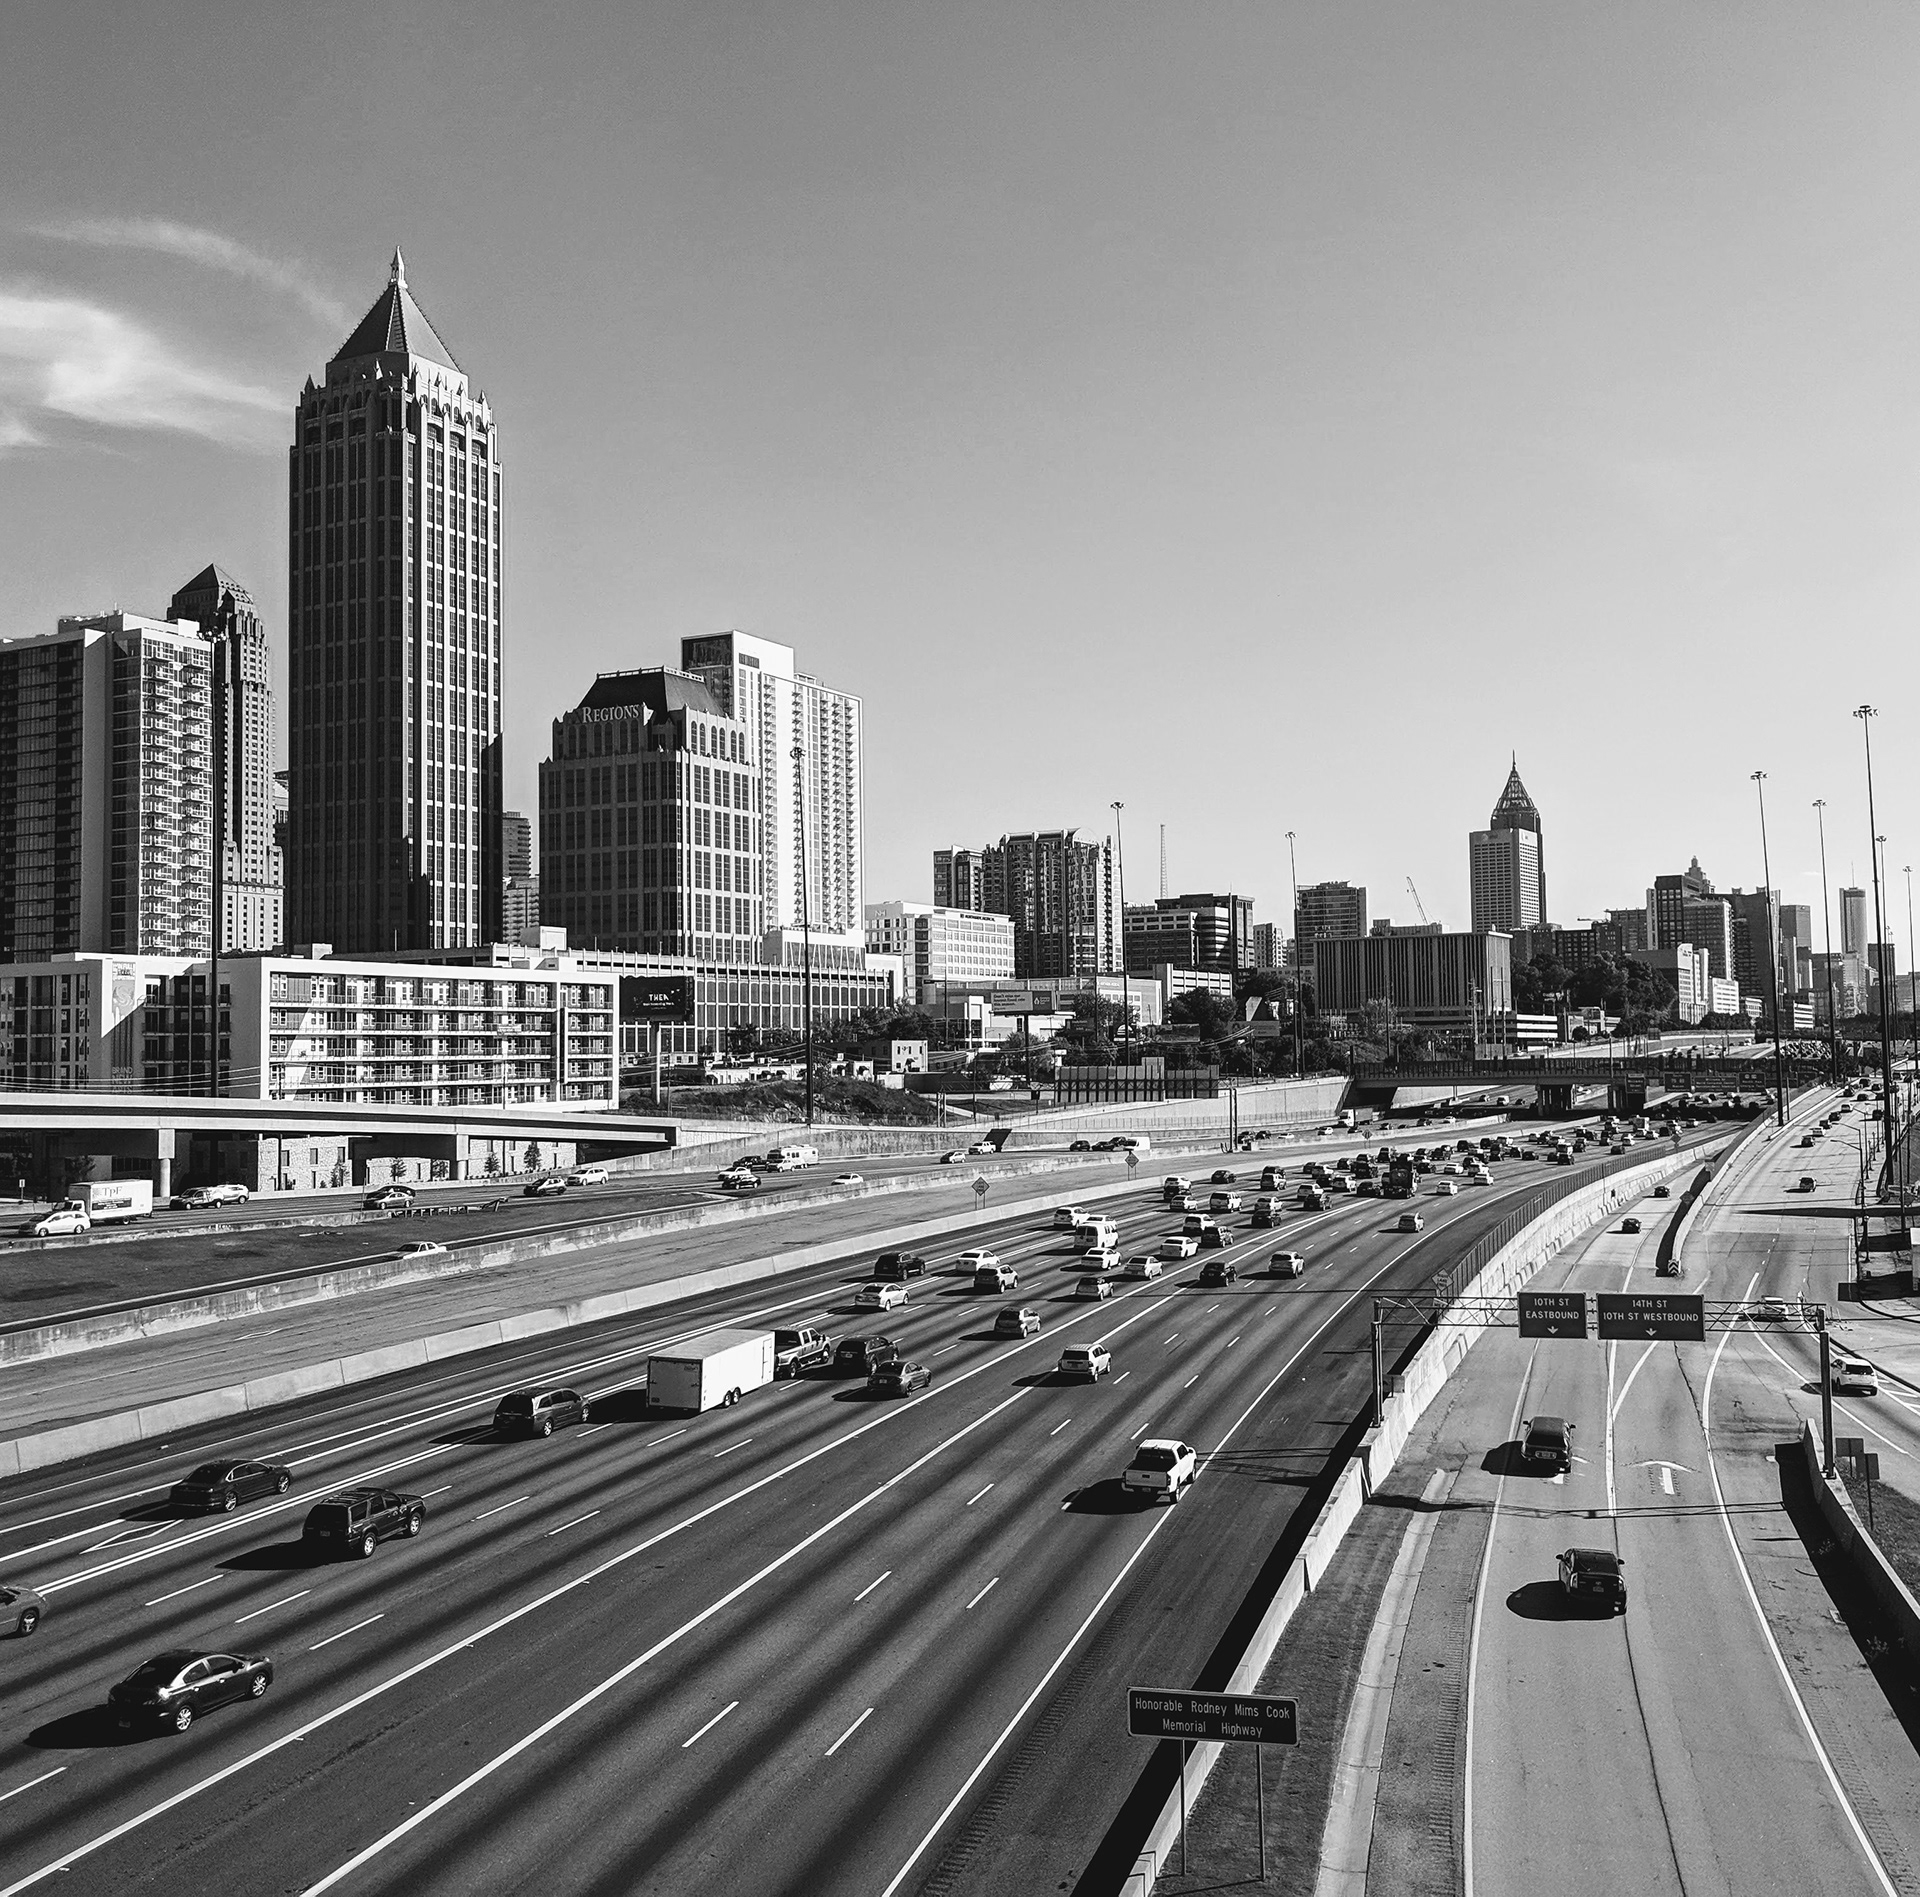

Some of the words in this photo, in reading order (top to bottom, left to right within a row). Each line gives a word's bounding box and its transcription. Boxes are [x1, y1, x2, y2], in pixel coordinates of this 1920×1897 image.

[582, 704, 640, 723] REGIONS
[1534, 1298, 1555, 1306] 10TH
[1558, 1298, 1570, 1306] ST
[1632, 1299, 1654, 1308] 14TH
[1656, 1300, 1668, 1308] ST
[1525, 1310, 1580, 1319] EASTBOUND
[1603, 1312, 1625, 1320] 10TH
[1628, 1312, 1639, 1321] ST
[1642, 1313, 1699, 1321] WESTBOUND
[1135, 1697, 1183, 1712] Honorable
[1191, 1700, 1227, 1717] Rodney
[1234, 1704, 1259, 1717] Mims
[1266, 1706, 1290, 1719] Cook
[1162, 1718, 1207, 1733] Memorial
[1221, 1722, 1263, 1738] Highway
